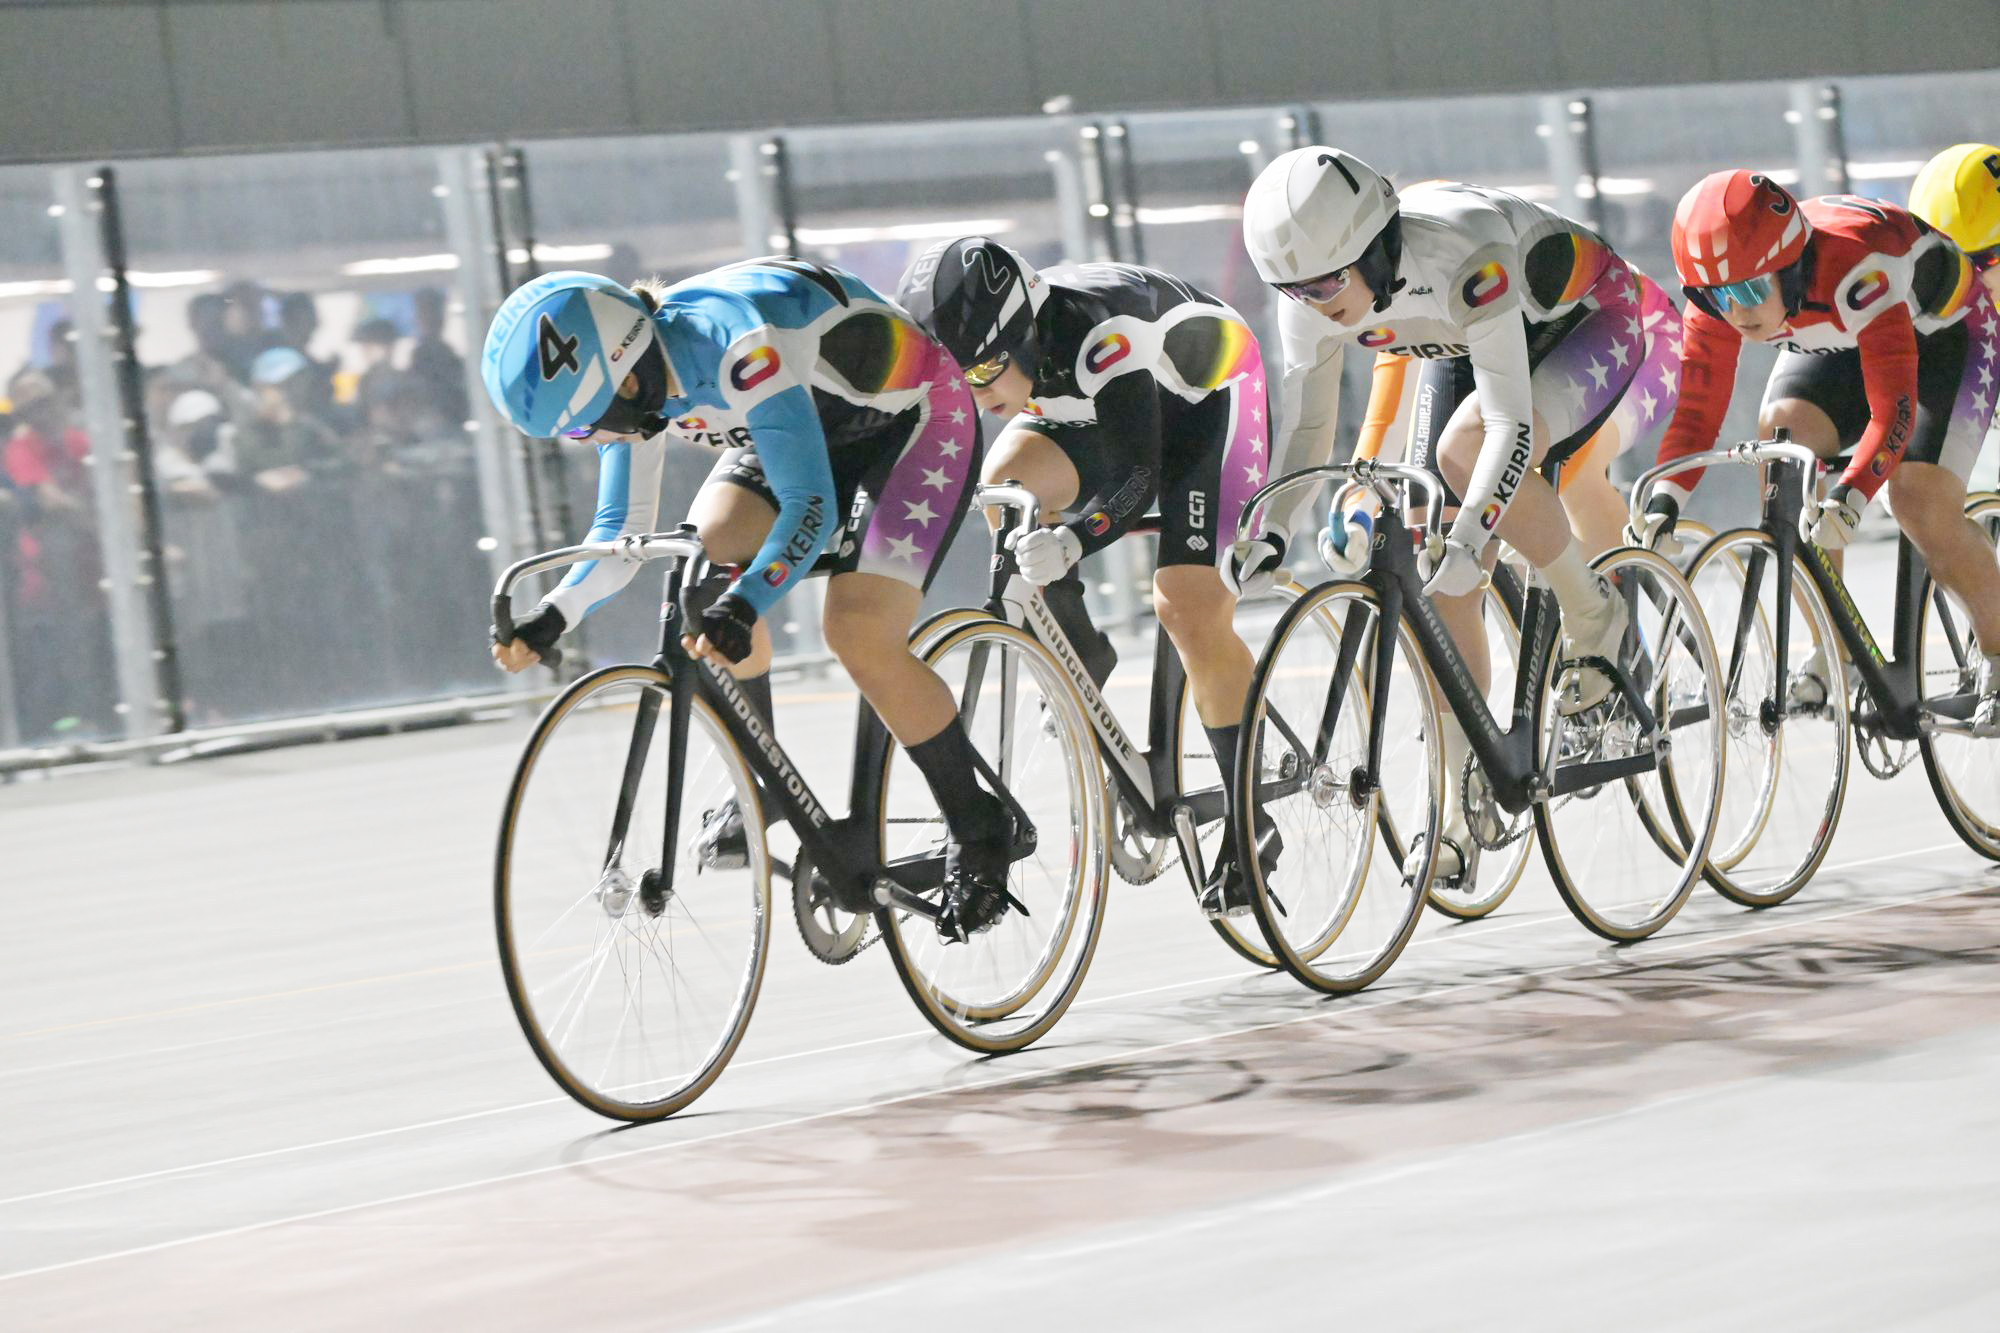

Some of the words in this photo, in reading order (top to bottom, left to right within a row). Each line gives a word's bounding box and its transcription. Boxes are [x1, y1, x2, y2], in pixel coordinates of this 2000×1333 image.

[1749, 175, 1791, 216] 3
[962, 247, 1010, 295] 2
[537, 311, 580, 382] 4
[621, 316, 646, 349] KEIRIN
[1887, 394, 1910, 455] KEIRIN
[1493, 422, 1531, 505] KEIRIN
[782, 495, 825, 568] KEIRIN
[1812, 542, 1885, 670] RIDGESTONE
[1030, 593, 1132, 761] BRIDGESTONE
[1417, 595, 1498, 743] BRIDGESTONE
[1523, 587, 1549, 721] BRIDGEST
